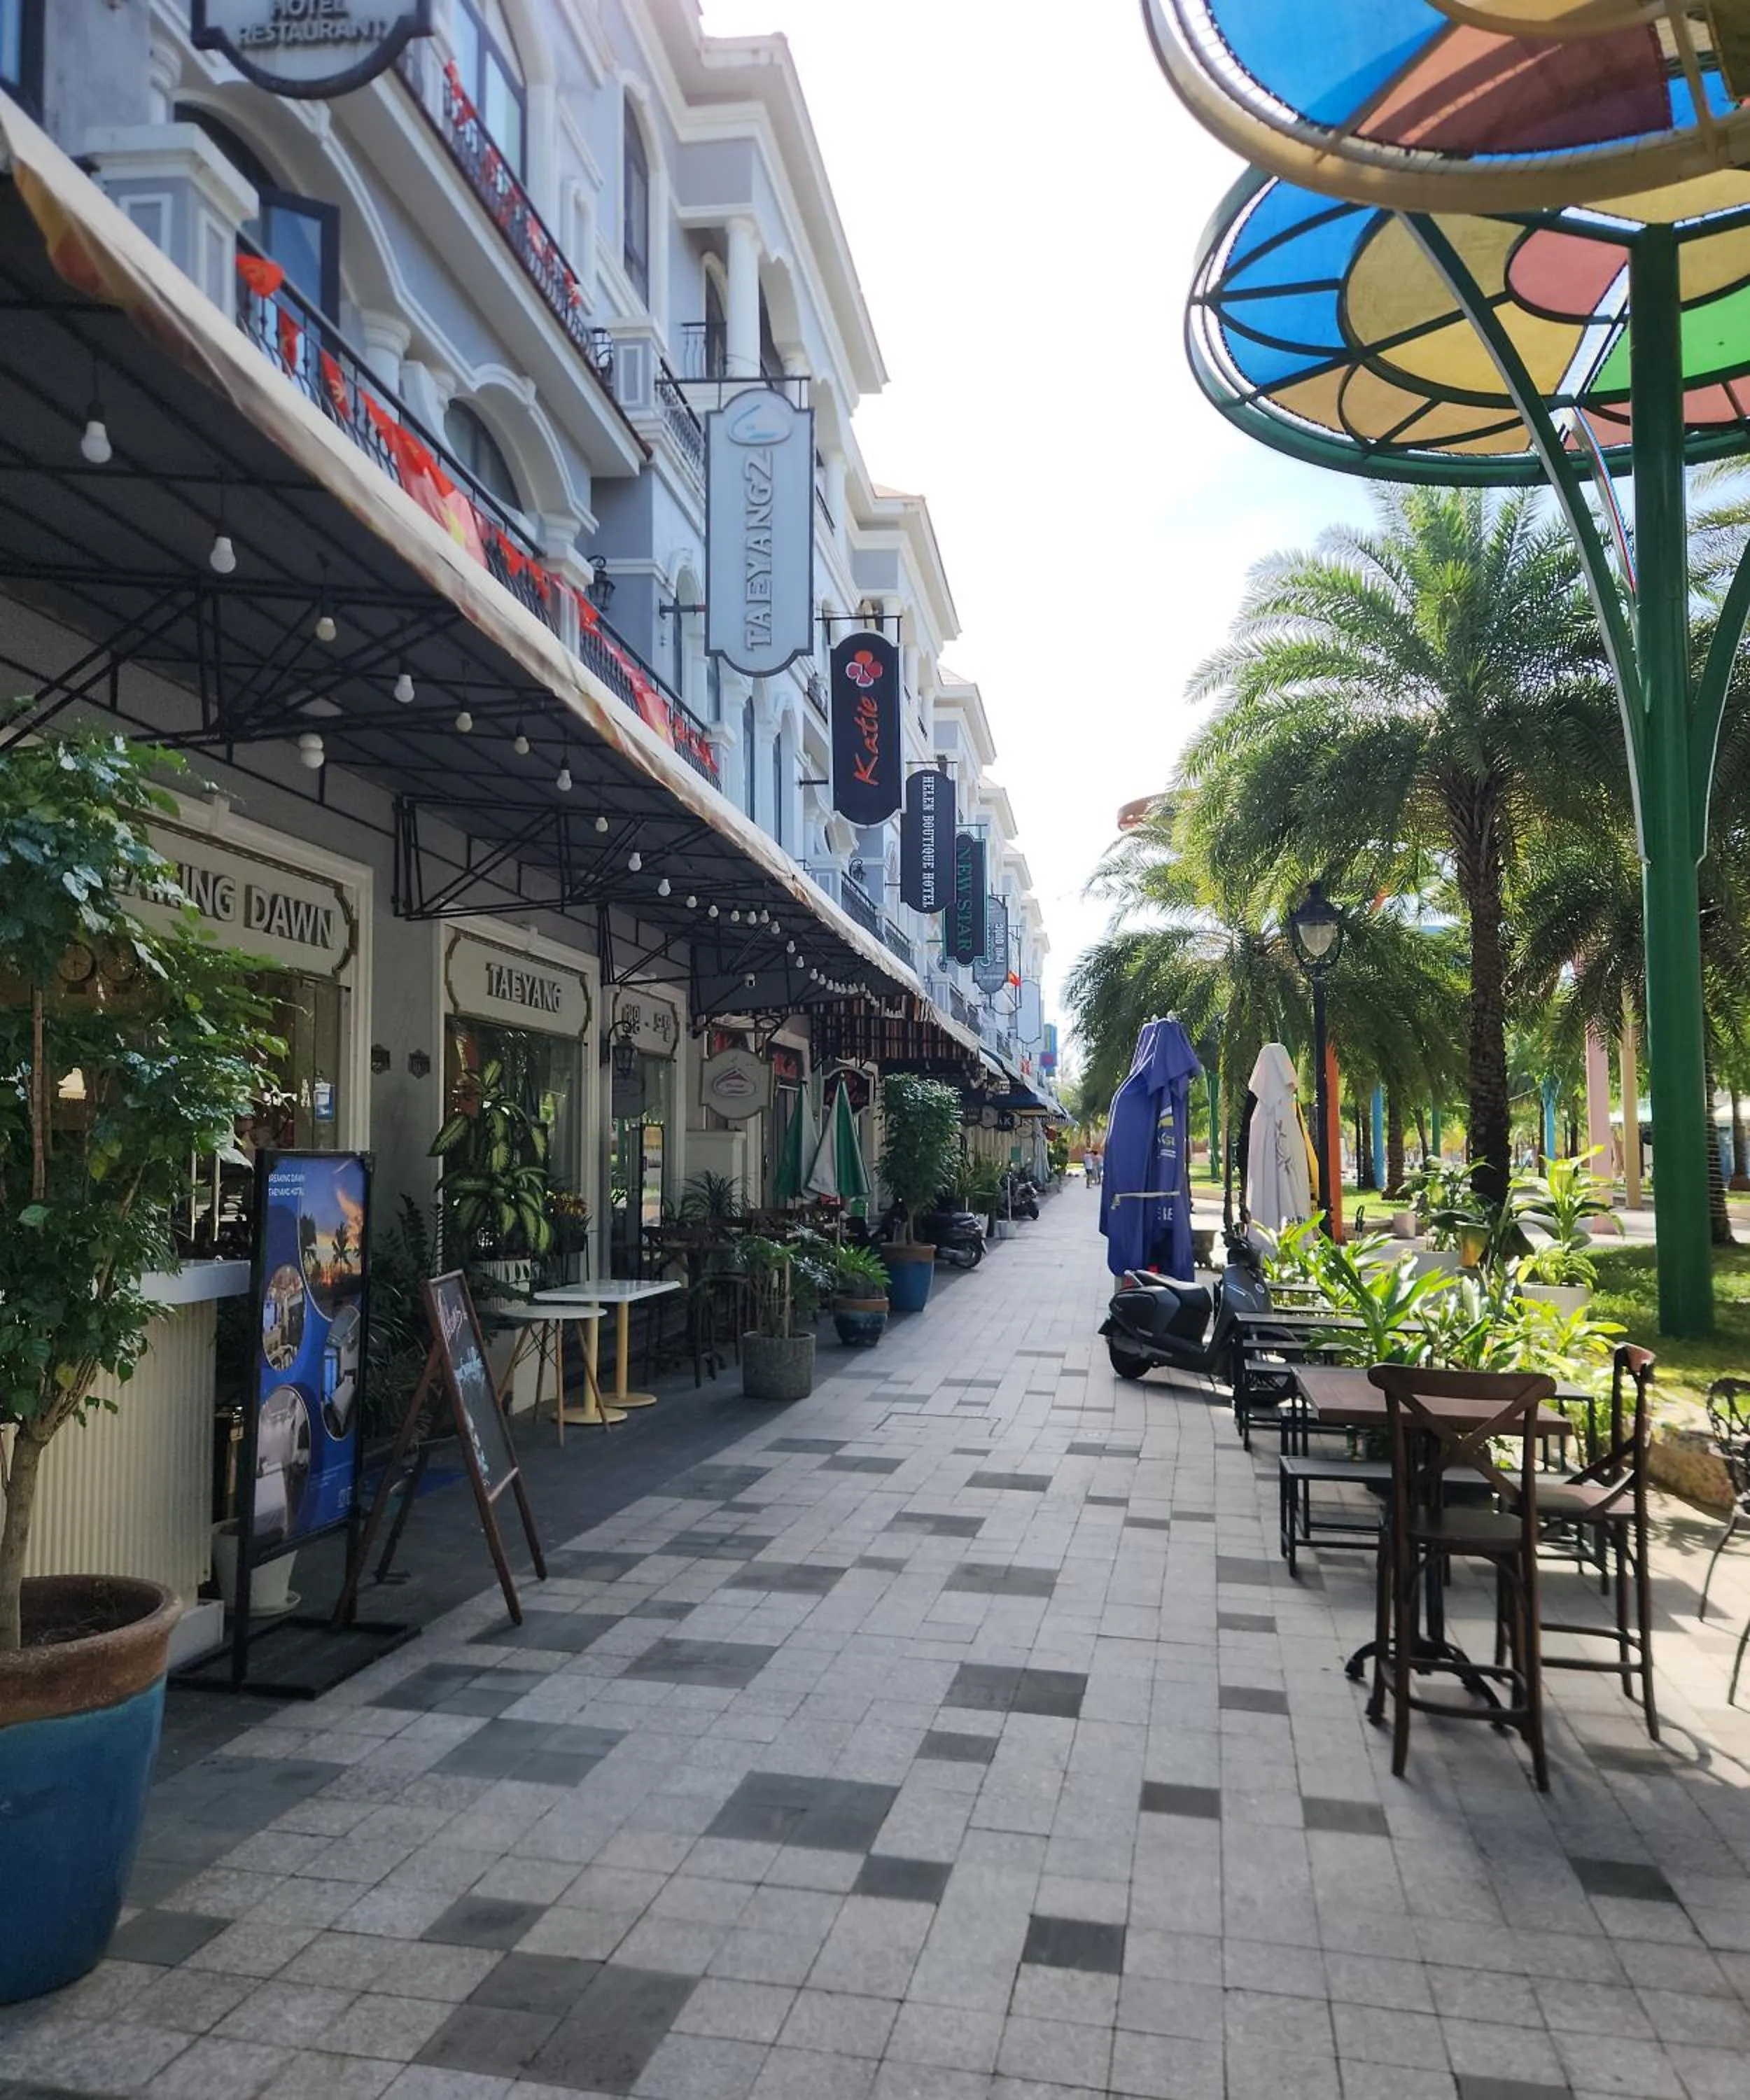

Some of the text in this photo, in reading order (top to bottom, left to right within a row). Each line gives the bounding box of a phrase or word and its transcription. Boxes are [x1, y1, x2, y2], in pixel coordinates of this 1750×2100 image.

[270, 0, 346, 20] HOTEL
[852, 694, 880, 785] Katie
[921, 776, 934, 909] HELEN BOUTIQUE HOTEL
[247, 883, 335, 949] DAWN
[957, 846, 972, 951] NEW STAR
[486, 962, 561, 1013] TAEYANG
